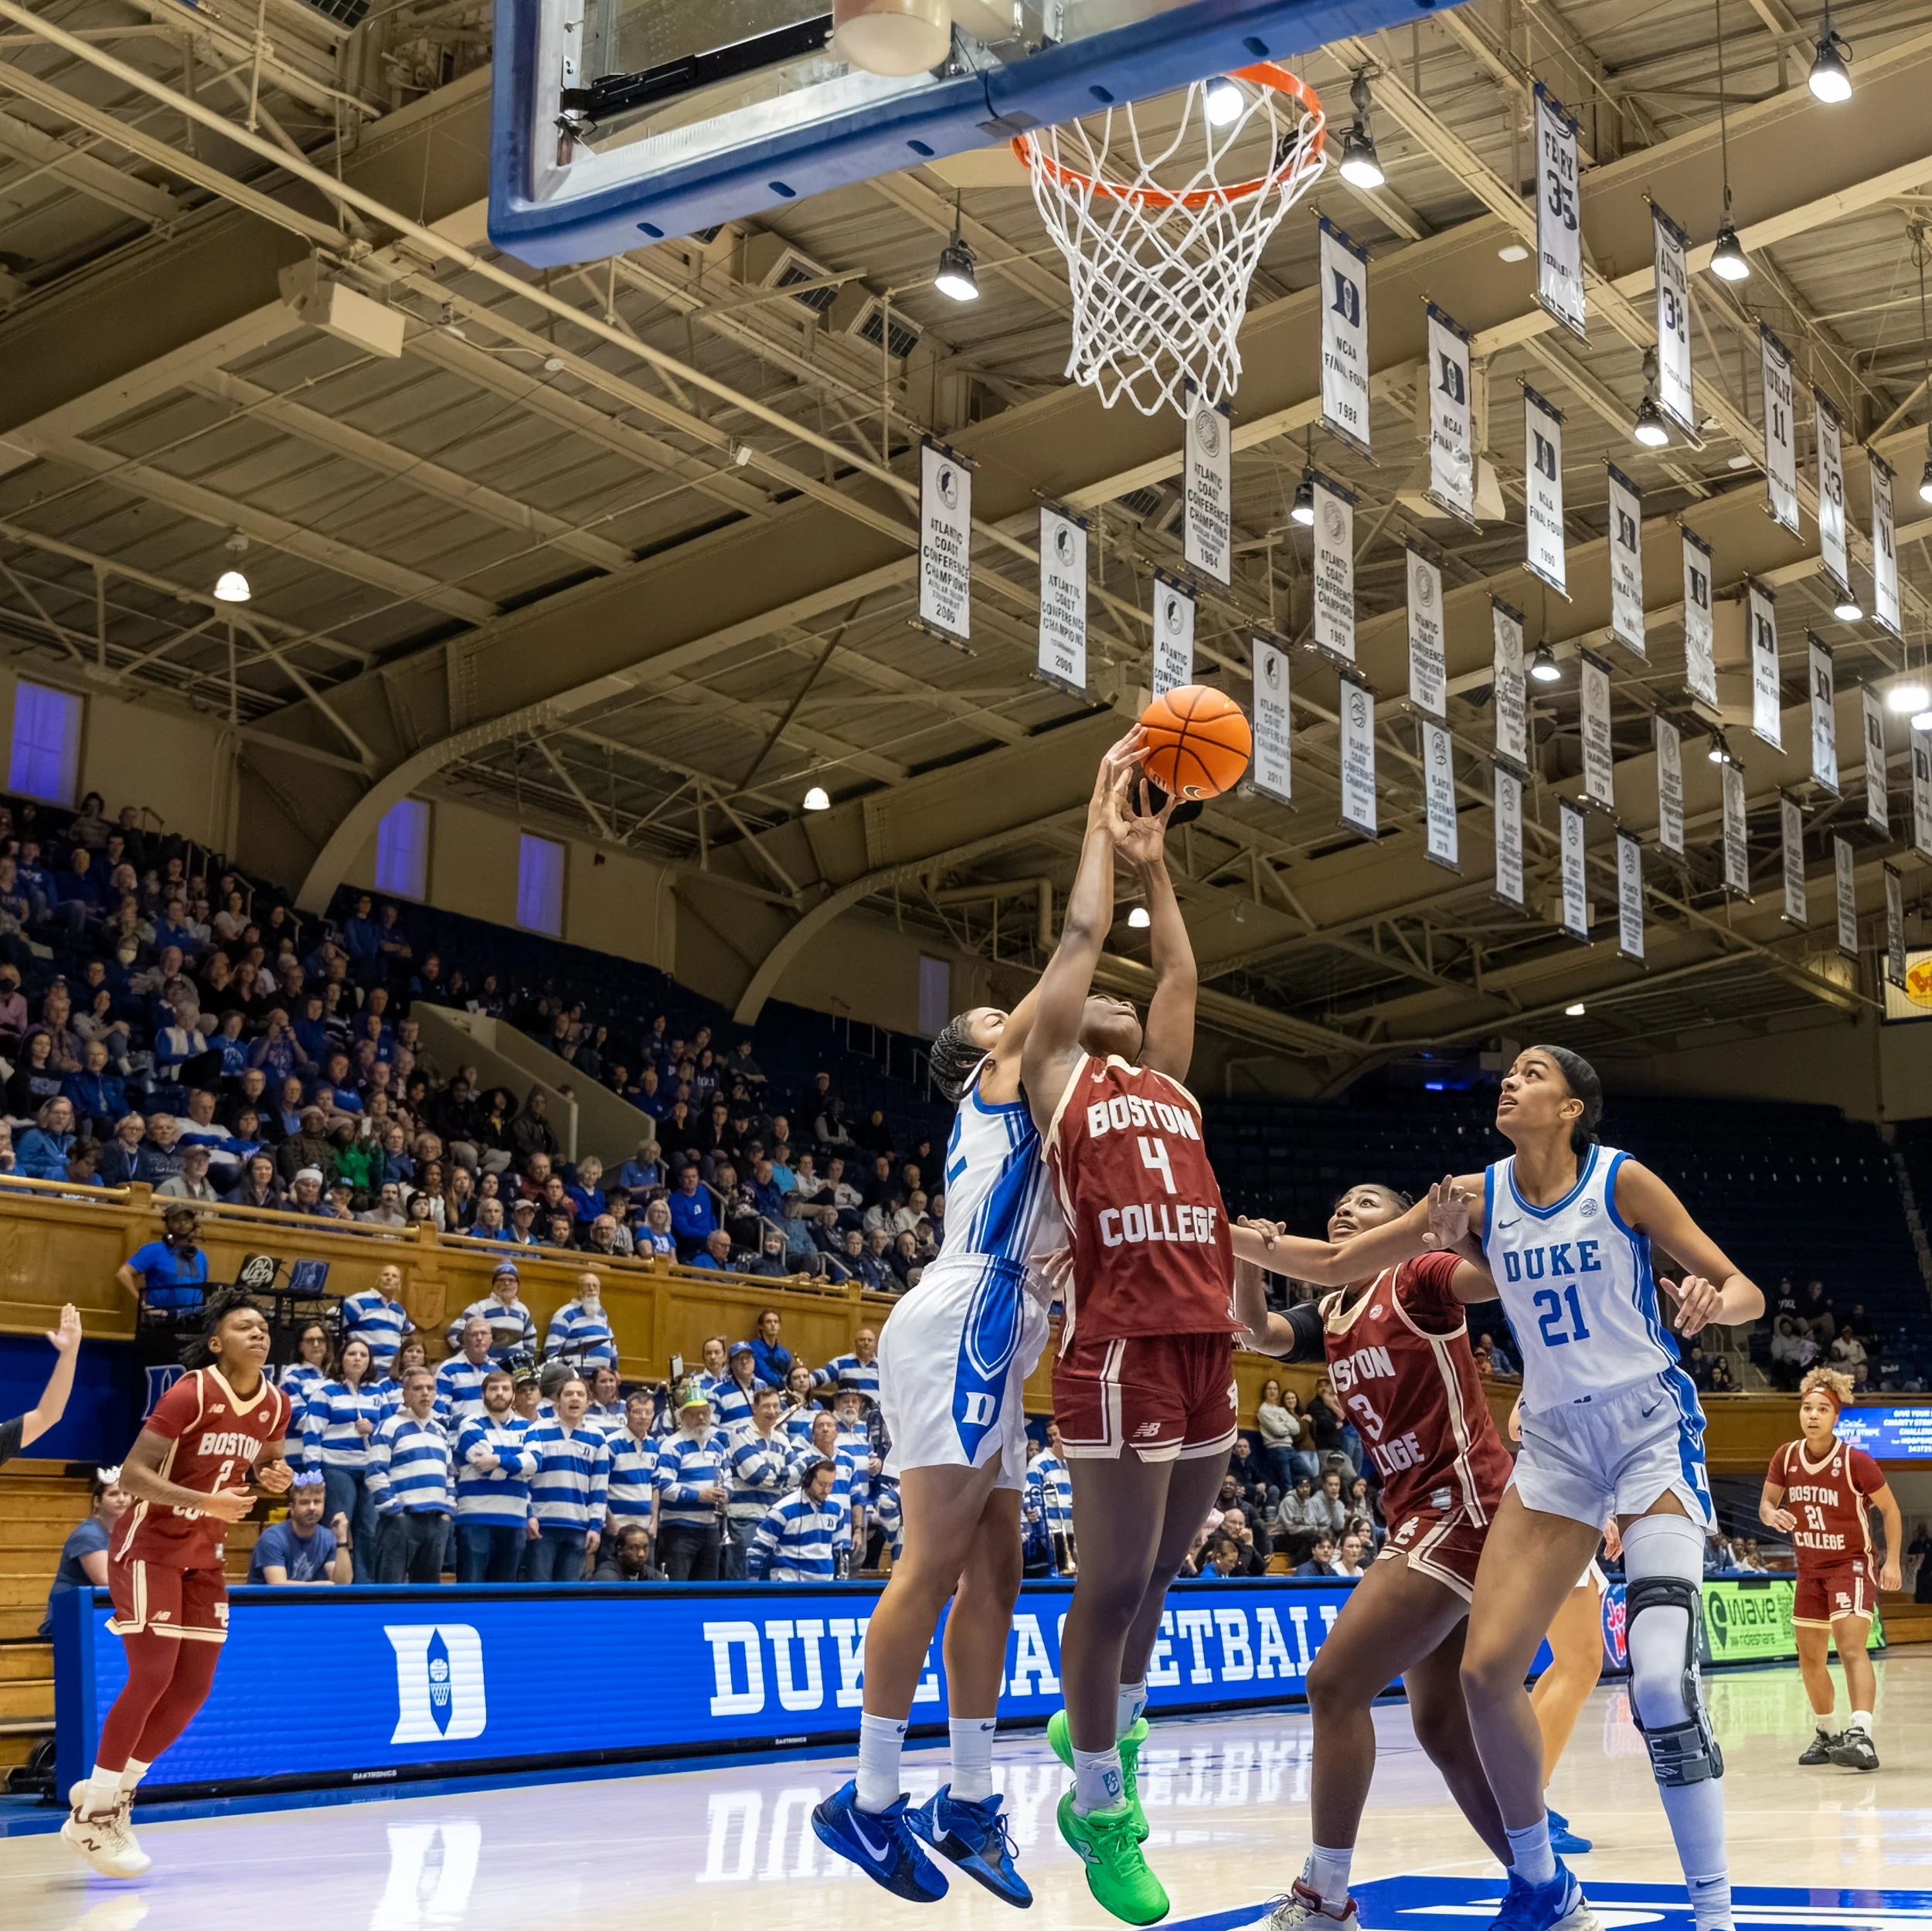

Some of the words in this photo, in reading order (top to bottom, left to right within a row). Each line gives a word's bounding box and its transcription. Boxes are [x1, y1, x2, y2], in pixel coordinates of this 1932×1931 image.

[1547, 169, 1578, 232] 35
[1336, 335, 1357, 363] NCAA
[1324, 352, 1348, 380] FINAL
[1338, 400, 1357, 425] 1988
[1443, 413, 1462, 438] NCAA
[1772, 402, 1787, 448] 11
[1434, 430, 1453, 453] FINAL
[1195, 461, 1223, 490] ATLANTIC
[1199, 480, 1219, 502] COAST
[1539, 490, 1553, 512] NCAA
[1188, 488, 1229, 525] CONFERENCE
[1530, 505, 1546, 527] FINAL
[930, 517, 963, 545] ATLANTIC
[1190, 507, 1227, 540] CHAMPIONS
[935, 535, 958, 557] COAST
[923, 545, 969, 580] CONFERENCE
[1321, 549, 1348, 574] ATLANTIC
[1326, 566, 1344, 585] COAST
[925, 563, 968, 594] CHAMPIONS
[1049, 574, 1080, 599] ATLANTIC
[1316, 575, 1353, 606] CONFERENCE
[1055, 592, 1076, 612] COAST
[1318, 590, 1352, 620] CHAMPIONS
[1042, 601, 1085, 633] CONFERENCE
[1043, 617, 1083, 646] CHAMPIONS
[1056, 655, 1073, 674] 2009
[1160, 642, 1188, 666] ATLANTIC
[1165, 658, 1183, 678] COAST
[1087, 1094, 1201, 1141] BOSTON
[1137, 1136, 1177, 1194] 4
[1098, 1203, 1217, 1248] COLLEGE
[1503, 1239, 1602, 1283] DUKE
[1533, 1283, 1590, 1347] 21
[1329, 1345, 1396, 1395] STON
[961, 1392, 996, 1426] D
[1348, 1393, 1384, 1441] 3
[198, 1433, 263, 1464] BOSTON
[1789, 1486, 1838, 1507] BOSTON
[1804, 1504, 1826, 1531] 21
[1794, 1532, 1845, 1551] COLLEGE
[1726, 1597, 1777, 1626] wave
[998, 1605, 1338, 1698] AETBAL
[384, 1623, 488, 1744] D
[352, 1770, 397, 1781] DAKTRONICS
